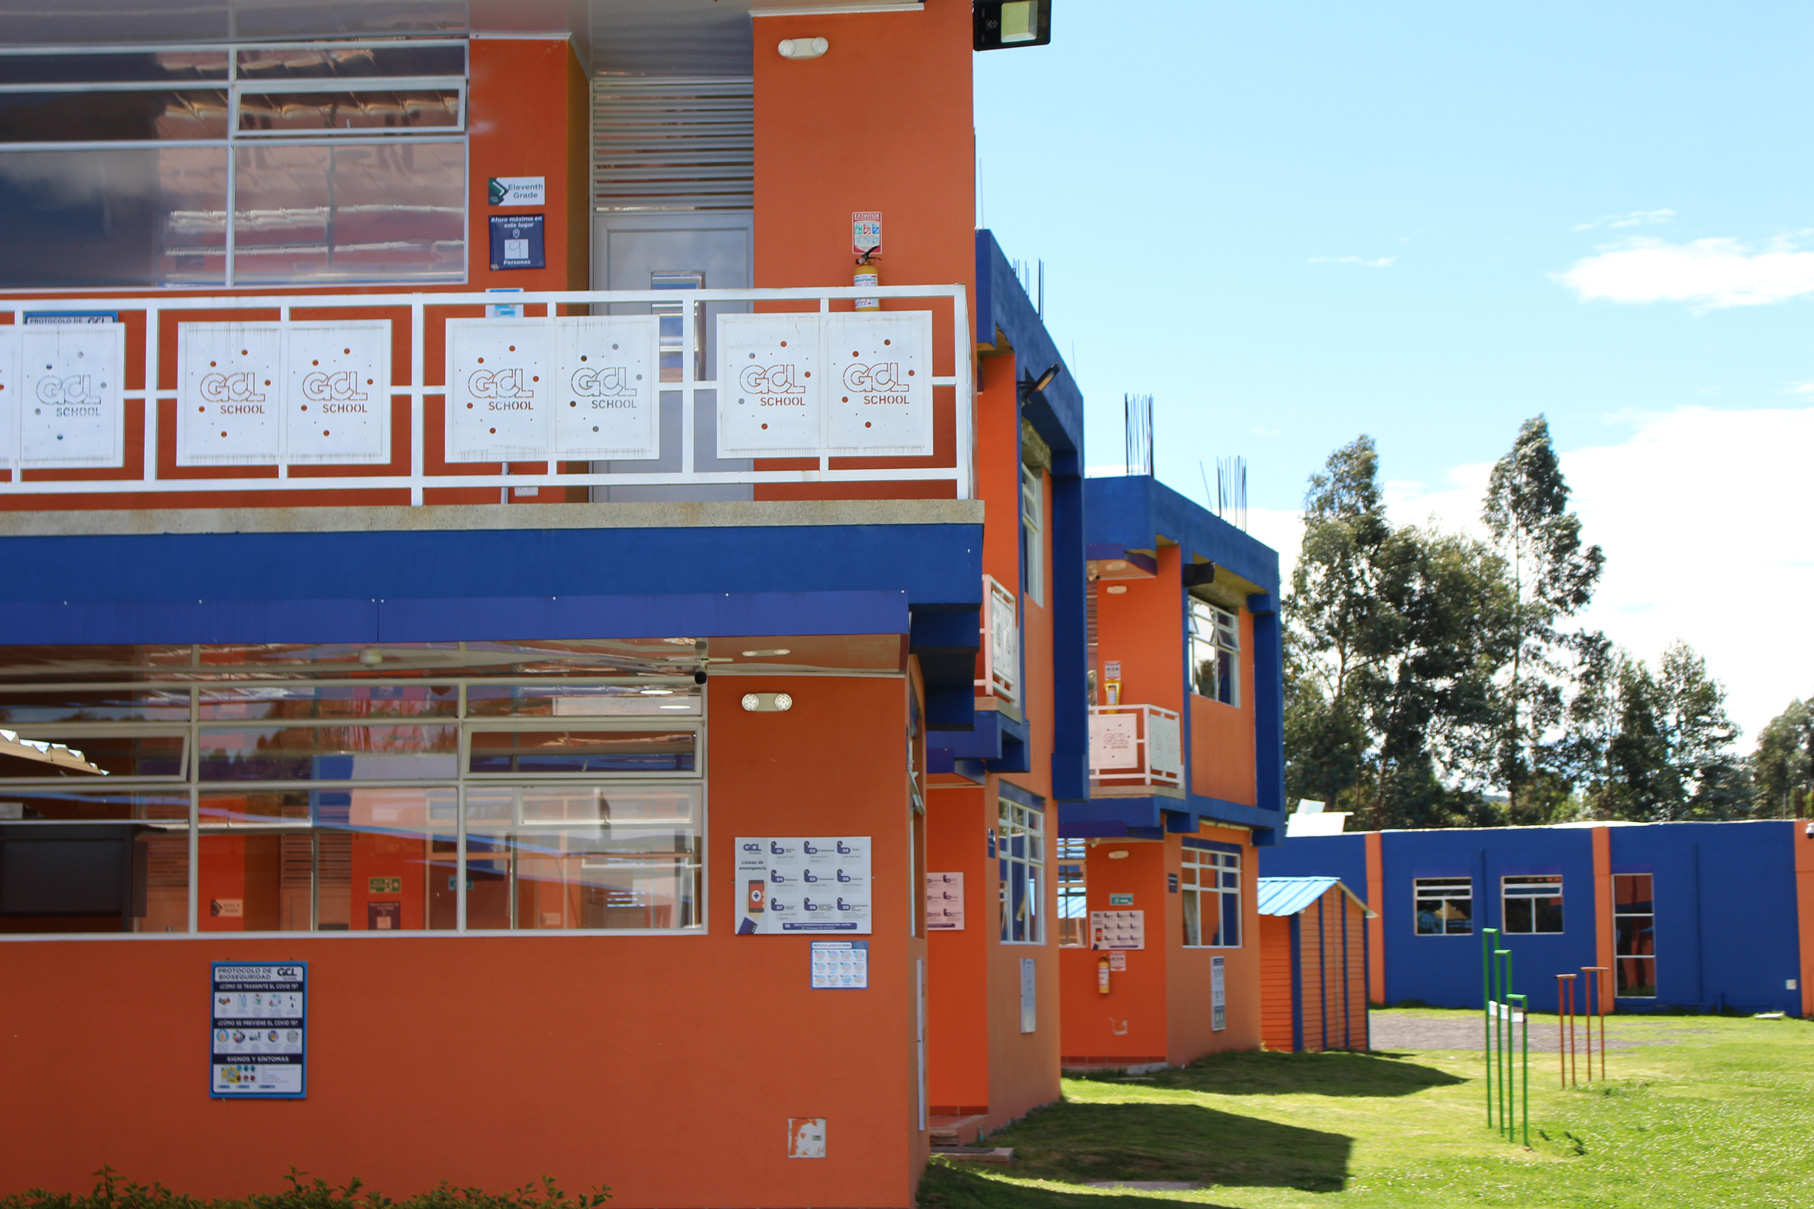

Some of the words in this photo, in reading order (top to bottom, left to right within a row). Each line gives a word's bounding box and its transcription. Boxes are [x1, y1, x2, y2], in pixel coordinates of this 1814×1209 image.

[571, 366, 637, 397] GCL
[739, 364, 806, 394] GCL
[843, 362, 909, 393] GCL
[200, 372, 266, 403] GCL
[303, 371, 368, 401] GCL
[468, 368, 534, 399] GCL
[36, 374, 102, 405] GCL
[489, 400, 534, 411] SCHOOL
[592, 399, 637, 409] SCHOOL
[760, 396, 806, 407] SCHOOL
[864, 395, 910, 405] SCHOOL
[56, 407, 101, 417] SCHOOL
[220, 404, 265, 414] SCHOOL
[322, 403, 368, 413] SCHOOL
[743, 843, 762, 852] GCL
[277, 967, 297, 977] GCL
